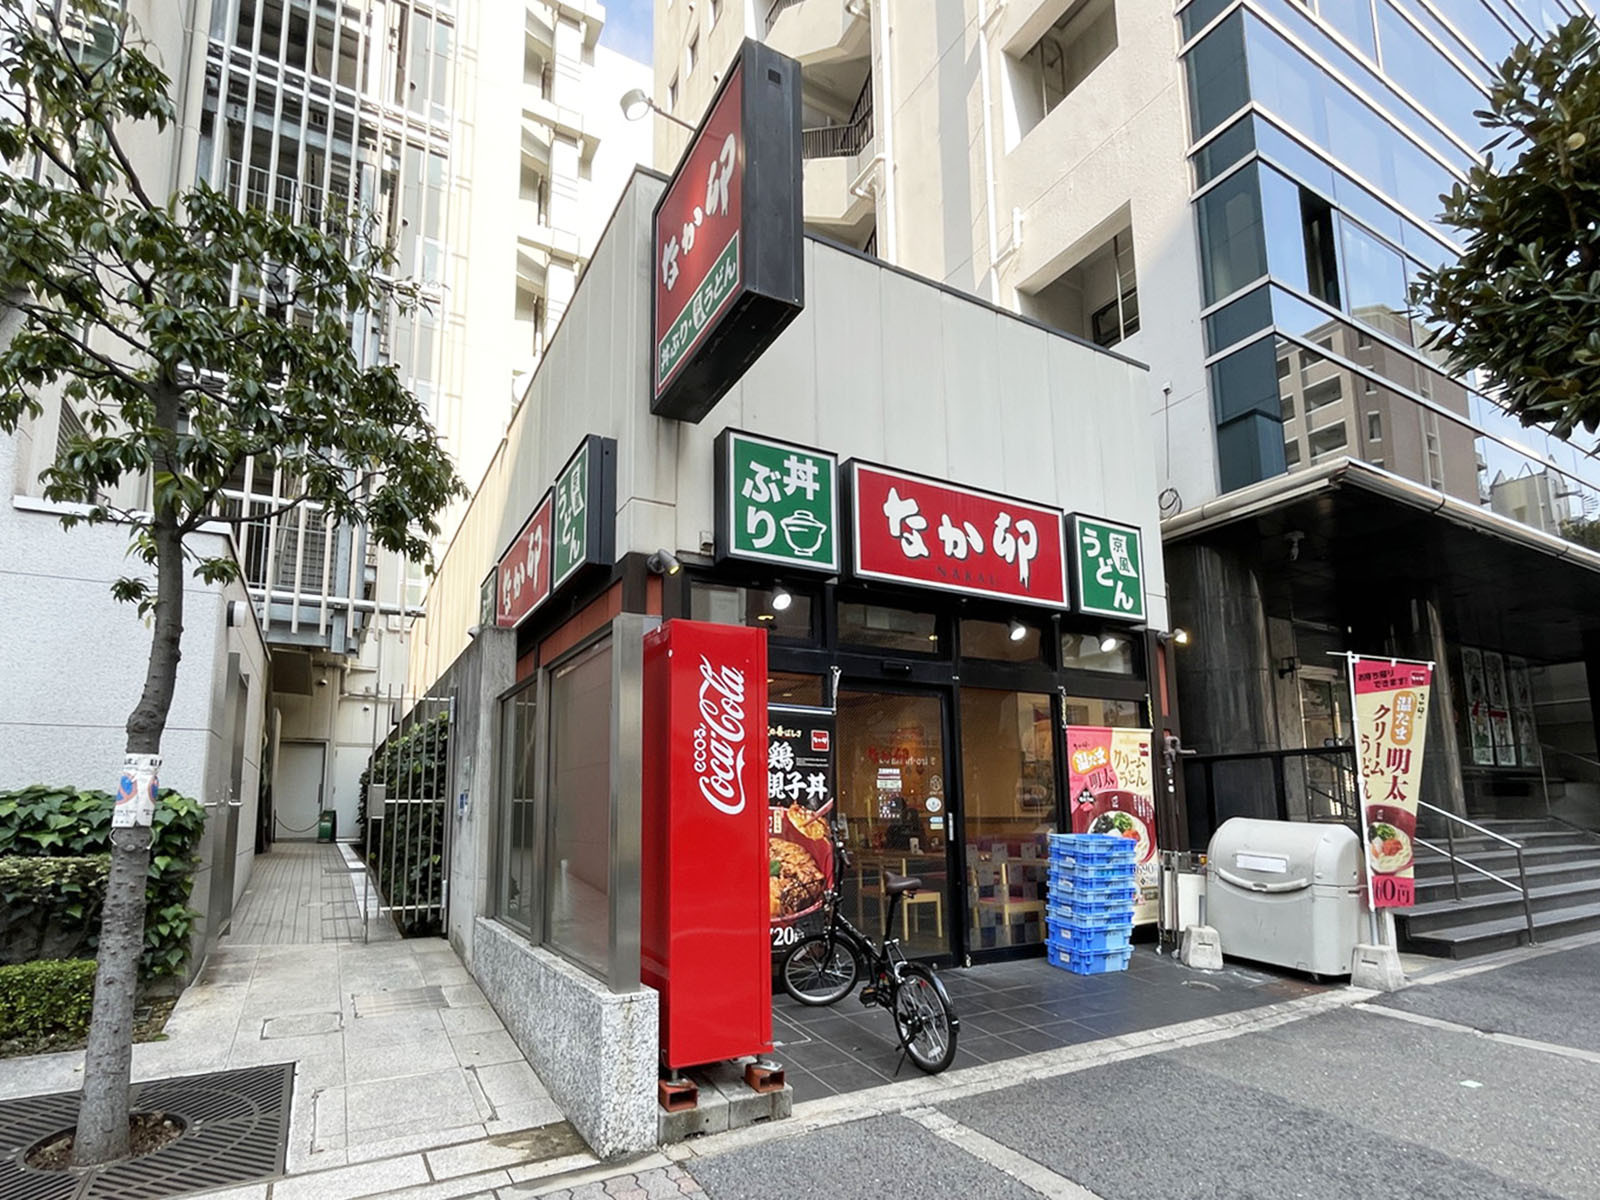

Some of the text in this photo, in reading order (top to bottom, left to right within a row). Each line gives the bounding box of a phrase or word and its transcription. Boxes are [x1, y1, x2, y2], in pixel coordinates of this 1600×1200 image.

[883, 487, 1039, 591] なか卯
[1082, 527, 1135, 611] うどん
[699, 653, 746, 815] Coca-Cola
[1360, 733, 1373, 800] うどん
[1371, 704, 1391, 776] クリーム
[1384, 747, 1412, 802] 明太
